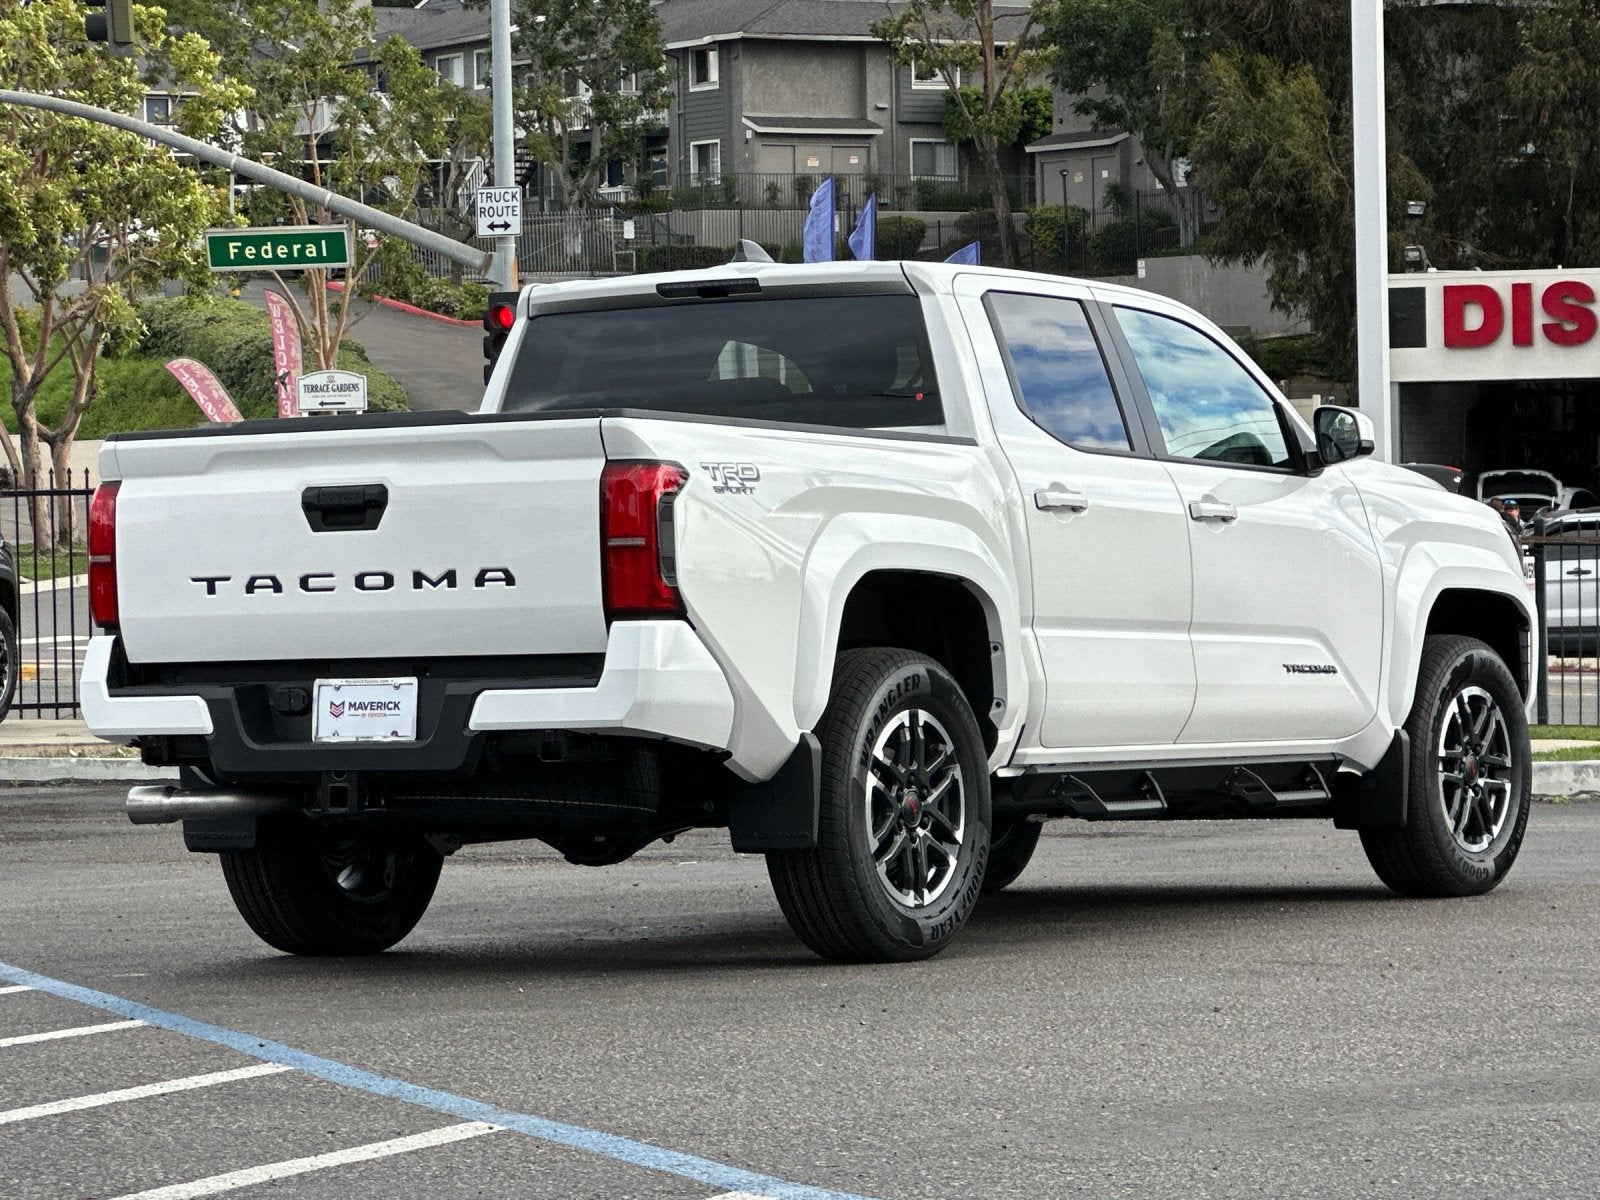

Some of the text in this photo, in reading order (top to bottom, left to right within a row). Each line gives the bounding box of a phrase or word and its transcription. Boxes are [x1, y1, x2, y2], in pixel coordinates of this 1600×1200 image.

[479, 191, 519, 203] TRUCK
[479, 206, 519, 218] ROUTE
[228, 239, 327, 260] Federal
[1443, 281, 1599, 348] DIS
[303, 383, 360, 393] TERRACE GARDENS
[699, 462, 761, 486] TRD
[712, 485, 757, 495] SPORT
[189, 567, 516, 595] TACOMA
[1282, 664, 1338, 674] TACOMA
[348, 701, 401, 711] MAVERICK
[859, 673, 921, 769] WRANGLER
[930, 844, 987, 941] GOODYEAR
